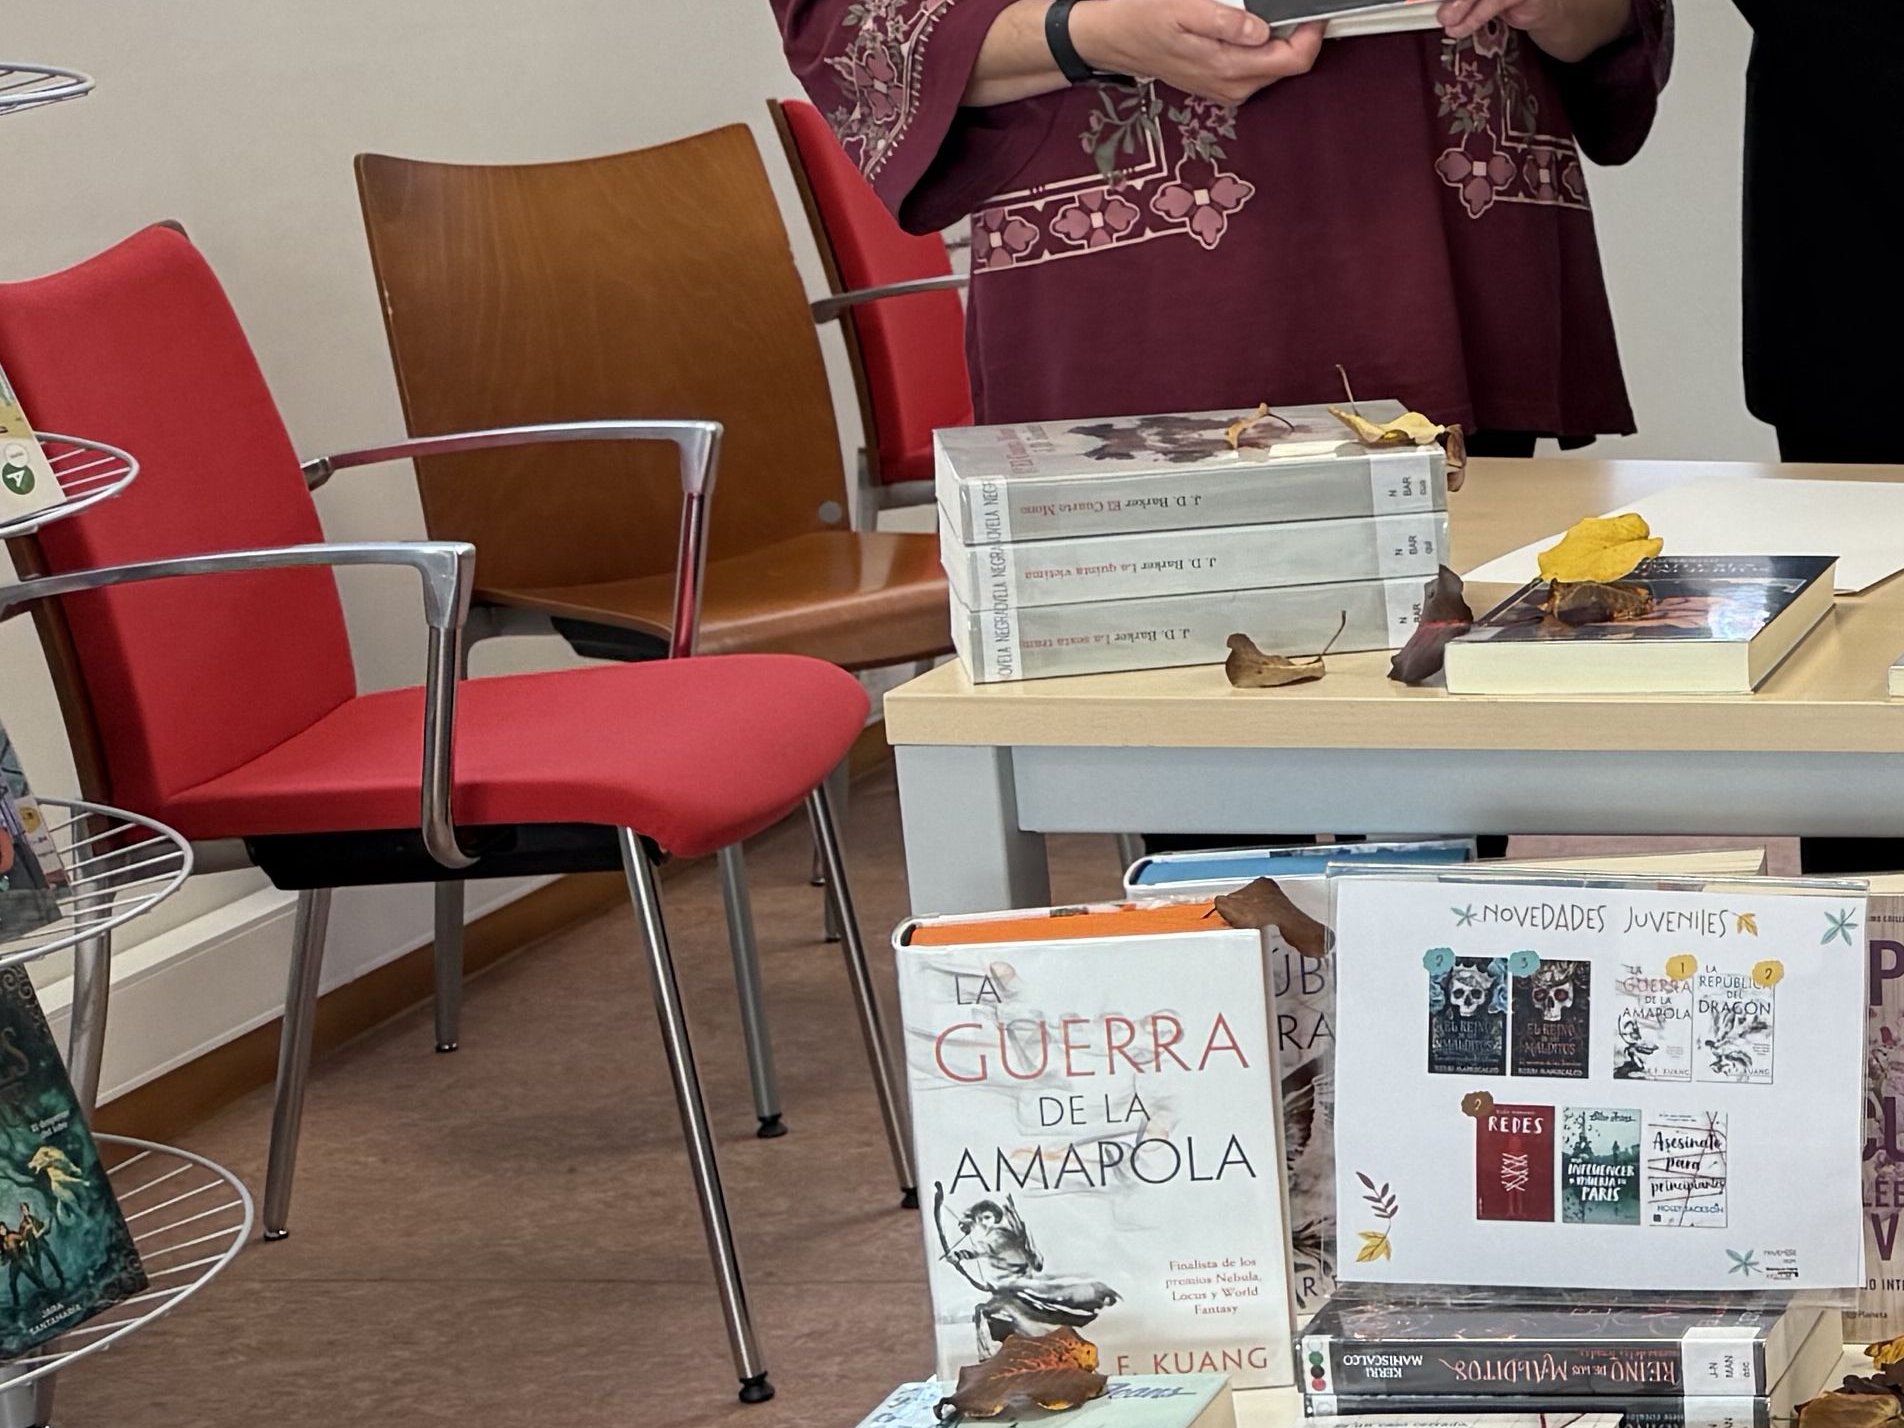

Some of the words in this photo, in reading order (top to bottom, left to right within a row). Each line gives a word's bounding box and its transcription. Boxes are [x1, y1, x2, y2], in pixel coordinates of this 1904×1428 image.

[1403, 476, 1412, 496] BAR
[1409, 535, 1417, 555] BAR
[1057, 635, 1090, 647] sexta
[1094, 633, 1110, 645] La
[1115, 630, 1157, 642] Barker
[1162, 628, 1175, 640] D.
[1179, 628, 1190, 639] J.
[1022, 637, 1053, 649] tram
[1482, 902, 1608, 934] NOVEDADES
[956, 973, 1002, 1005] LA
[1622, 976, 1691, 994] GUERRA
[1726, 990, 1743, 1000] DEL
[1622, 1005, 1692, 1019] AMAPOLA
[1699, 997, 1771, 1015] DRAGÓN
[935, 1012, 1250, 1083] GUERRA
[1038, 1094, 1085, 1127] DE
[1105, 1092, 1151, 1123] LA
[1488, 1115, 1544, 1134] REDES
[1652, 1130, 1722, 1151] Asesinato
[949, 1134, 1257, 1195] AMAPOLA
[1665, 1156, 1701, 1172] para
[1168, 1259, 1218, 1271] Finalista
[1220, 1257, 1238, 1269] de
[1240, 1256, 1257, 1267] los
[1165, 1275, 1213, 1289] premios
[1216, 1271, 1262, 1285] Nebula,
[1172, 1289, 1207, 1301] Locus
[1210, 1290, 1219, 1301] y
[1222, 1285, 1259, 1297] World
[1194, 1302, 1239, 1317] Fantasy
[1343, 1354, 1424, 1368] MANISCALCO
[1724, 1355, 1734, 1378] MAN
[1366, 1365, 1402, 1380] KERRI
